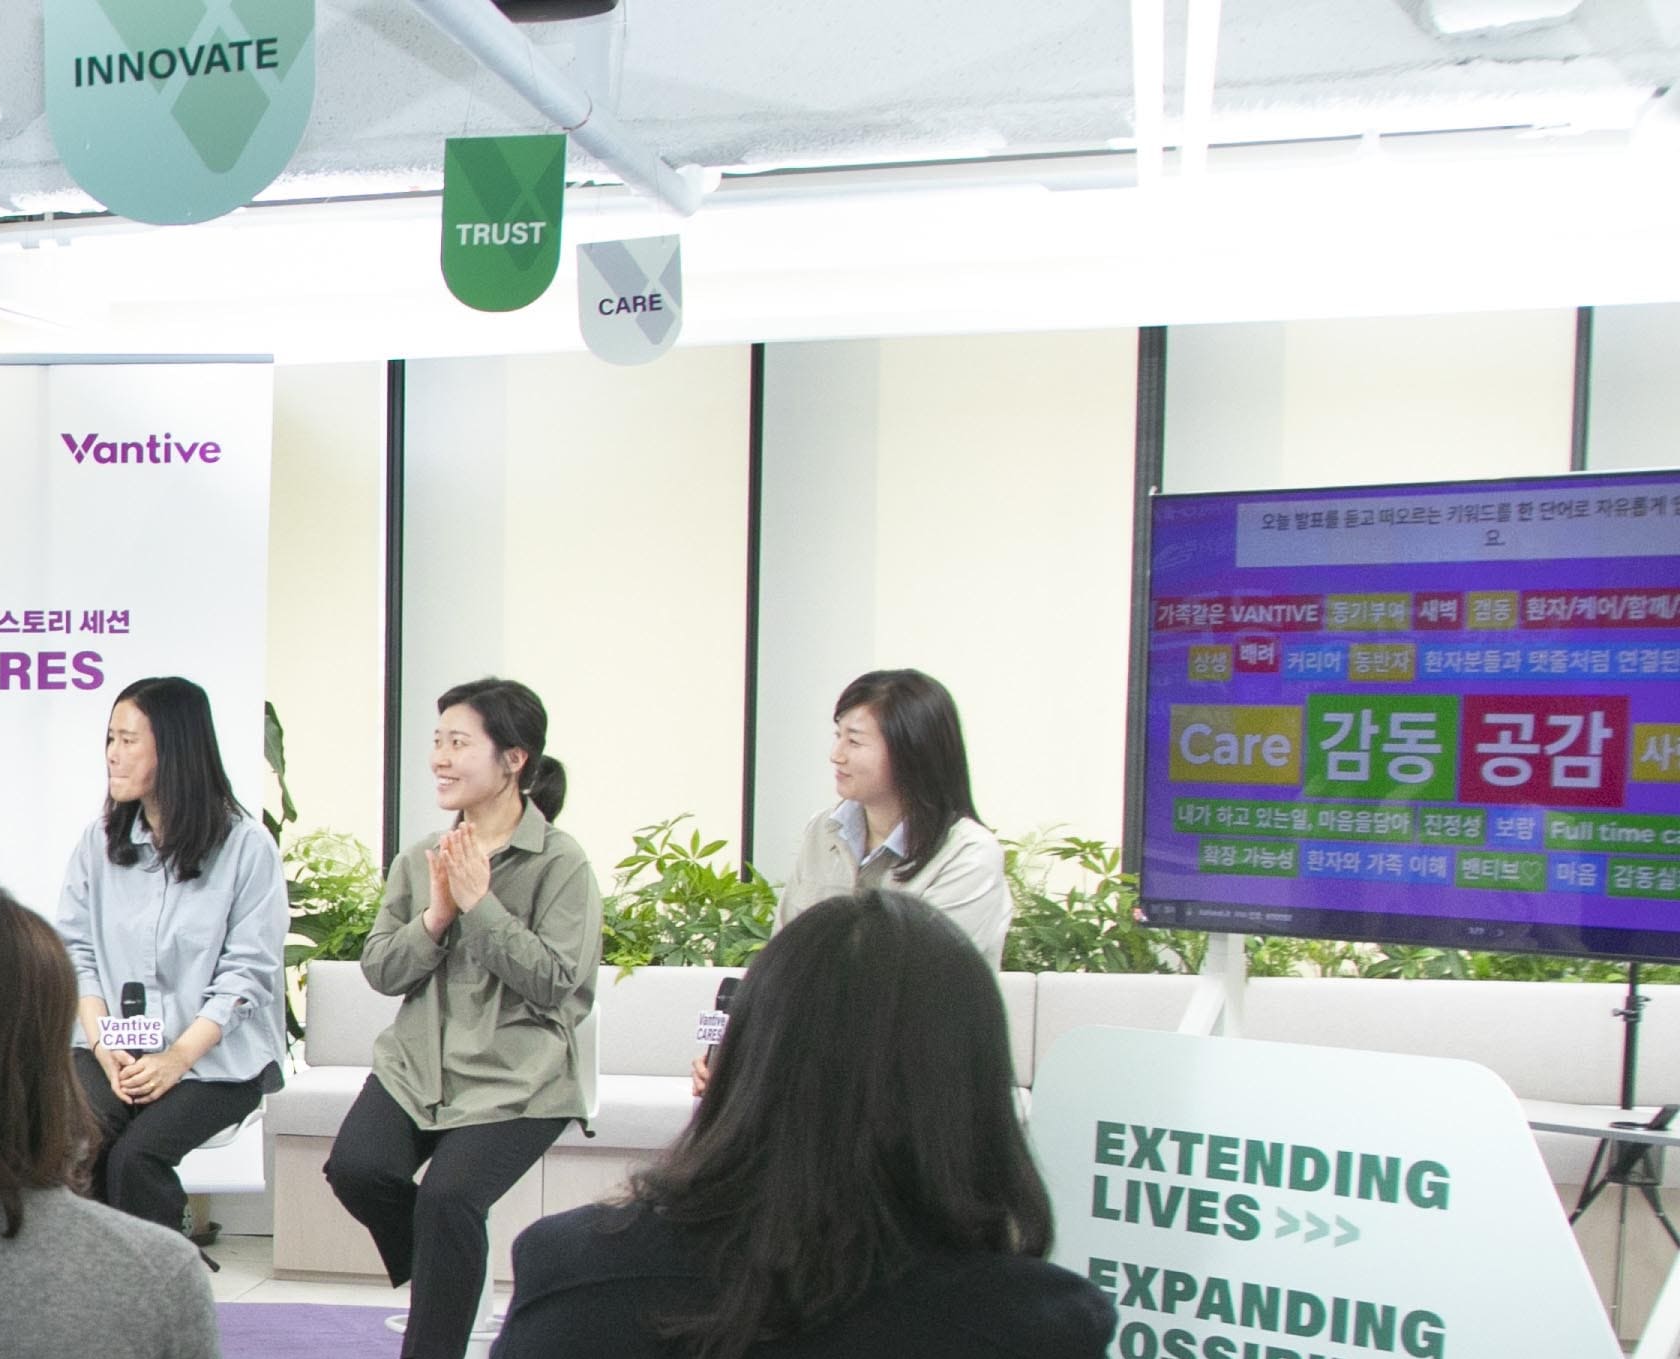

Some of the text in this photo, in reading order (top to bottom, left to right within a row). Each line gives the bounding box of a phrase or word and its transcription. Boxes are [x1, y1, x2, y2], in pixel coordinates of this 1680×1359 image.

[73, 36, 280, 88] INNOVATE
[457, 221, 546, 247] TRUST
[599, 292, 663, 316] CARE
[61, 433, 221, 465] Vantive
[1262, 513, 1290, 531] 오늘
[1379, 505, 1441, 525] 떠오르는
[1447, 502, 1511, 524] 키워드를
[1518, 501, 1534, 522] 한
[1541, 500, 1590, 521] 단어로
[1158, 603, 1318, 624] 가족같은 VANTIVE
[1420, 599, 1457, 622] 새벽
[1526, 594, 1680, 622] 환자/케어/함께/
[79, 609, 131, 635] 세션
[1194, 653, 1226, 673] 상생
[1240, 643, 1274, 665] 배려
[1288, 652, 1340, 673] 커리어
[1354, 651, 1409, 673] 동반자
[1425, 650, 1520, 673] 환자분들과
[1179, 723, 1291, 767] Care
[1320, 709, 1442, 784] 감동
[1476, 711, 1613, 788] 공감
[1641, 734, 1680, 771] 사
[1178, 806, 1211, 826] 내가
[1217, 807, 1250, 828] 하고
[1425, 814, 1481, 838] 진정성
[1496, 816, 1536, 840] 보람
[1551, 821, 1592, 841] Full
[1599, 822, 1656, 843] time
[1242, 847, 1294, 870] 가능성
[1307, 850, 1447, 879] 환자와 가족 이해
[1556, 862, 1598, 888] 마음
[1615, 865, 1680, 890] 감동실
[101, 1018, 161, 1032] Vantive
[103, 1033, 159, 1046] CARES
[1095, 1119, 1450, 1211] EXTENDING
[1091, 1174, 1261, 1241] LIVES
[1088, 1256, 1446, 1359] EXPANDING
